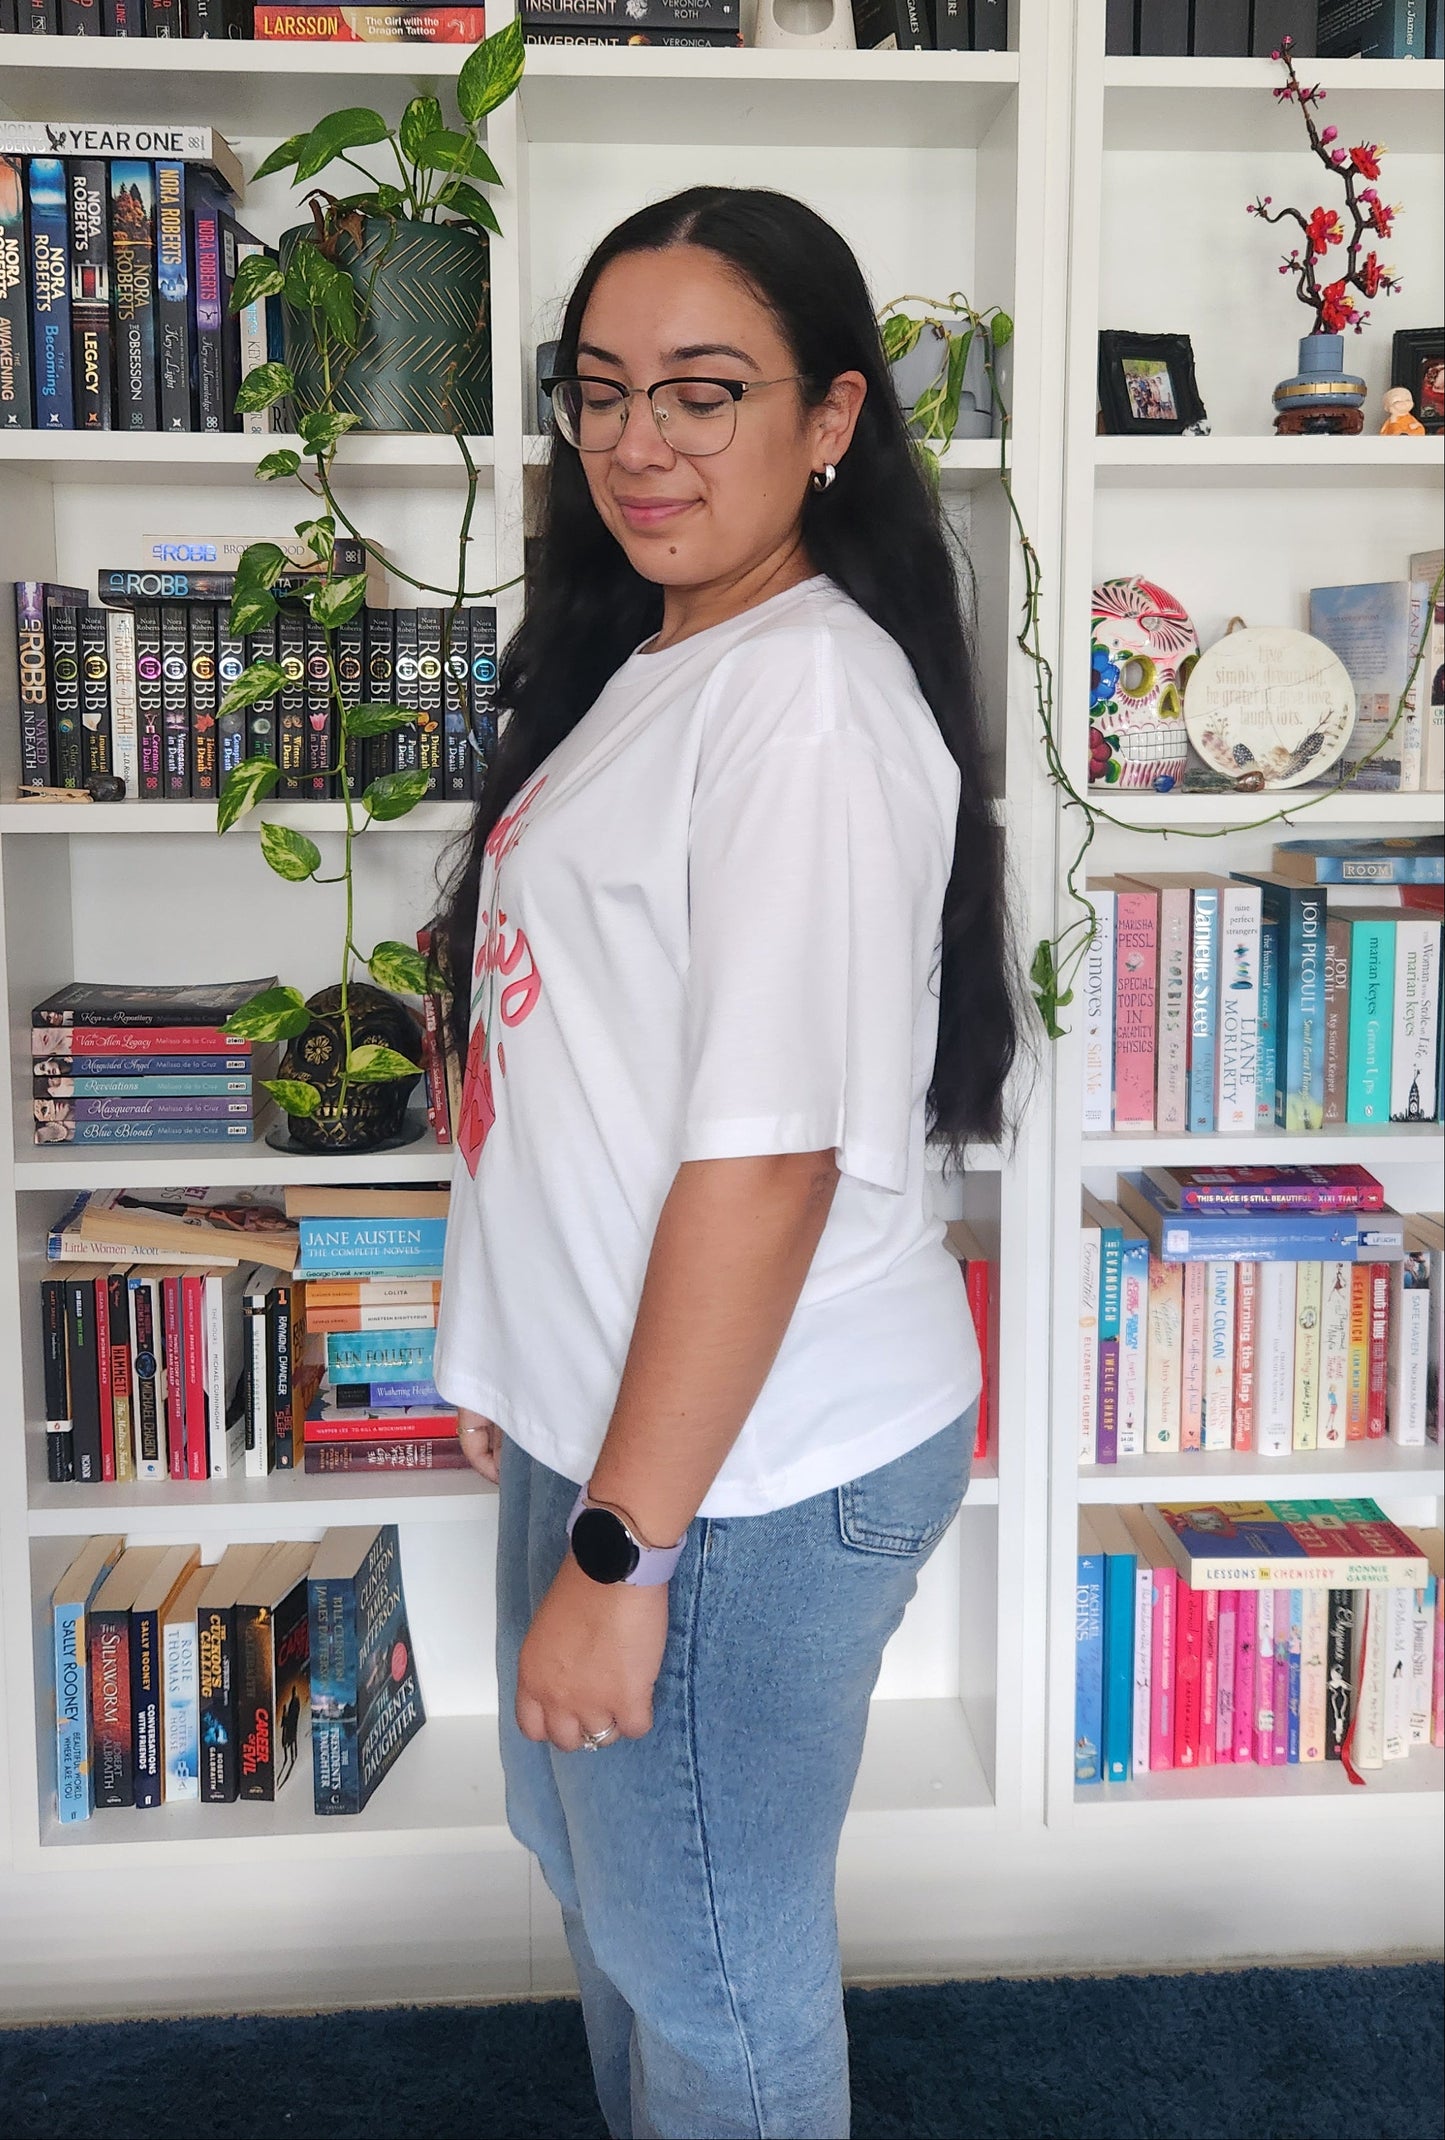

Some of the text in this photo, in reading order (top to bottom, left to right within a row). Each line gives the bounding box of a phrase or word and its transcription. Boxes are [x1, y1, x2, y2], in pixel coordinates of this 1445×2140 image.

[264, 16, 338, 36] LARSSON
[368, 26, 436, 37] Dragon Tattoo
[525, 0, 617, 15] INSURGENT
[674, 9, 699, 19] ROTH
[662, 37, 712, 48] VERONICA
[69, 131, 184, 152] YEAR ONE
[73, 176, 89, 251] ROBERTS
[87, 190, 101, 238] NORA
[159, 169, 182, 266] NORA ROBERTS
[5, 238, 21, 288] NORA
[34, 234, 52, 313] ROBERTS
[50, 247, 66, 300] NORA
[116, 250, 135, 321] ROBERTS
[133, 264, 150, 308] NORA
[198, 219, 218, 301] NORA ROBERTS
[0, 318, 15, 401] AWAKENING
[42, 325, 60, 397] Becoming
[84, 332, 99, 395] LEGACY
[128, 330, 143, 401] OBSESSION
[20, 619, 44, 632] J.D.
[85, 617, 101, 625] Nora
[418, 623, 441, 631] Roberts
[19, 632, 48, 705] ROBB
[54, 640, 79, 711] ROBB
[82, 640, 108, 711] ROBB
[138, 640, 162, 711] ROBB
[163, 640, 188, 711] ROBB
[192, 640, 216, 711] ROBB
[418, 640, 441, 711] ROBB
[472, 642, 496, 714] ROBB
[24, 710, 37, 770] IN DEATH
[35, 719, 48, 765] NAKED
[1346, 865, 1390, 876] ROOM
[1118, 919, 1154, 930] MARISHA
[1226, 928, 1258, 936] strangers
[1230, 915, 1255, 926] perfect
[1234, 904, 1250, 912] nine
[1118, 933, 1154, 949] PESSL
[1192, 894, 1217, 1038] Danielle Steel
[1300, 901, 1320, 1016] JODI PICOULT
[1118, 977, 1154, 991] SPECIAL
[1118, 993, 1154, 1008] TOPICS
[1324, 945, 1336, 1003] PICOULT
[1334, 958, 1348, 990] JODI
[1366, 936, 1379, 1016] marian keyes
[1405, 951, 1417, 1037] marian keyes
[1117, 1025, 1153, 1039] CALAMITY
[1127, 1010, 1143, 1024] IN
[1117, 1040, 1153, 1054] PHYSICS
[1223, 1000, 1239, 1104] MORIARTY
[1240, 1018, 1256, 1086] LIANE
[1266, 1048, 1275, 1084] LIANE
[83, 1122, 154, 1138] Blue Bloods
[87, 1100, 153, 1119] Masquerade
[1318, 1194, 1335, 1202] XIXI
[1338, 1194, 1358, 1202] TIAN
[64, 1242, 159, 1256] Little Women Alcott
[305, 1230, 421, 1246] JANE AUSTEN
[309, 1246, 421, 1257] THE COMPLETE NOVELS
[278, 1289, 288, 1305] 1
[1104, 1251, 1119, 1322] EVANOVICH
[1212, 1269, 1228, 1360] JENNY COLGAN
[1352, 1278, 1364, 1343] EVANOVICH
[112, 1348, 128, 1394] HAMMETT
[278, 1316, 288, 1397] RAYMOND CHANDLER
[336, 1347, 425, 1369] KEN FOLLETT
[1238, 1286, 1254, 1403] Burning the Map
[1082, 1336, 1091, 1437] ELIZABETH GILBERT
[1103, 1352, 1116, 1431] TWELVE SHARP
[275, 1411, 286, 1439] SLEEP
[1244, 1407, 1252, 1431] Laura
[360, 1541, 394, 1609] CLINTON
[368, 1536, 384, 1570] BILL
[1346, 1574, 1390, 1583] GARMUS
[1348, 1565, 1388, 1573] BONNIE
[359, 1585, 400, 1670] PATTERSON
[366, 1579, 389, 1627] JAMES
[1076, 1584, 1090, 1641] JOHNS
[1089, 1584, 1100, 1640] RACHAEL
[62, 1619, 79, 1722] SALLY ROONEY
[101, 1633, 121, 1723] SILKWORM
[141, 1619, 151, 1692] SALLY ROONEY
[168, 1630, 181, 1693] THOMAS
[181, 1639, 193, 1682] ROSIE
[200, 1630, 212, 1699] CALLING
[210, 1613, 222, 1689] CUCKOO'S
[361, 1675, 416, 1766] PRESIDENT'S
[376, 1687, 389, 1709] THE
[103, 1730, 114, 1790] GALBRAITH
[113, 1740, 123, 1777] ROBERT
[137, 1710, 147, 1771] WITH FRIENDS
[147, 1703, 157, 1775] CONVERSATIONS
[242, 1743, 256, 1776] EVIL
[255, 1708, 269, 1764] CAREER
[320, 1730, 331, 1788] DAUGHTER
[364, 1701, 417, 1786] DAUGHTER
[64, 1737, 73, 1799] WHERE ARE YOU
[217, 1752, 225, 1784] ROBERT
